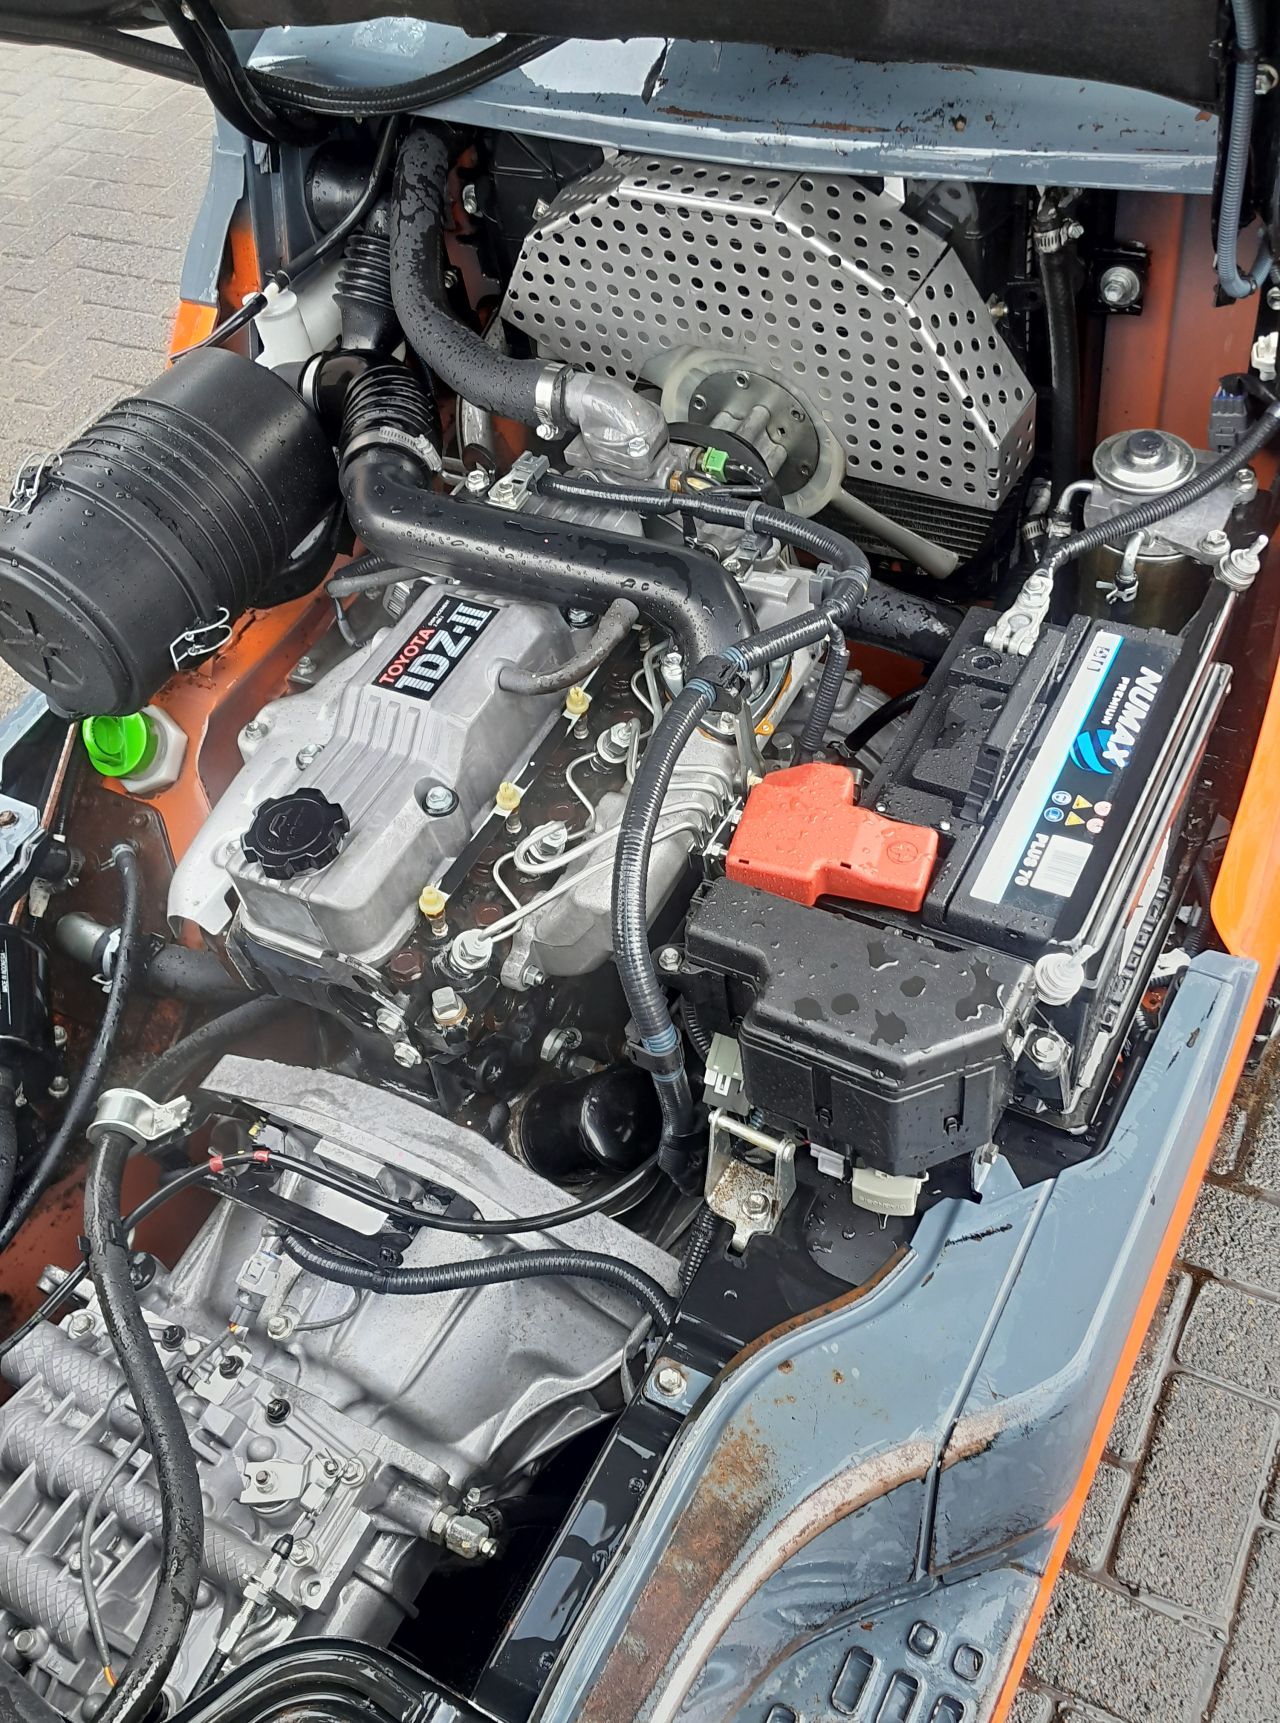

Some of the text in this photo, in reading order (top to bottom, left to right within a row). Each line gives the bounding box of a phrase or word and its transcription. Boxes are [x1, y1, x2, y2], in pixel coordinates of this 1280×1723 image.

[379, 627, 436, 684] TOYOTA
[1101, 677, 1130, 725] PREMIUM
[1102, 666, 1163, 767] NUMAX
[1014, 833, 1049, 886] PLUS 70
